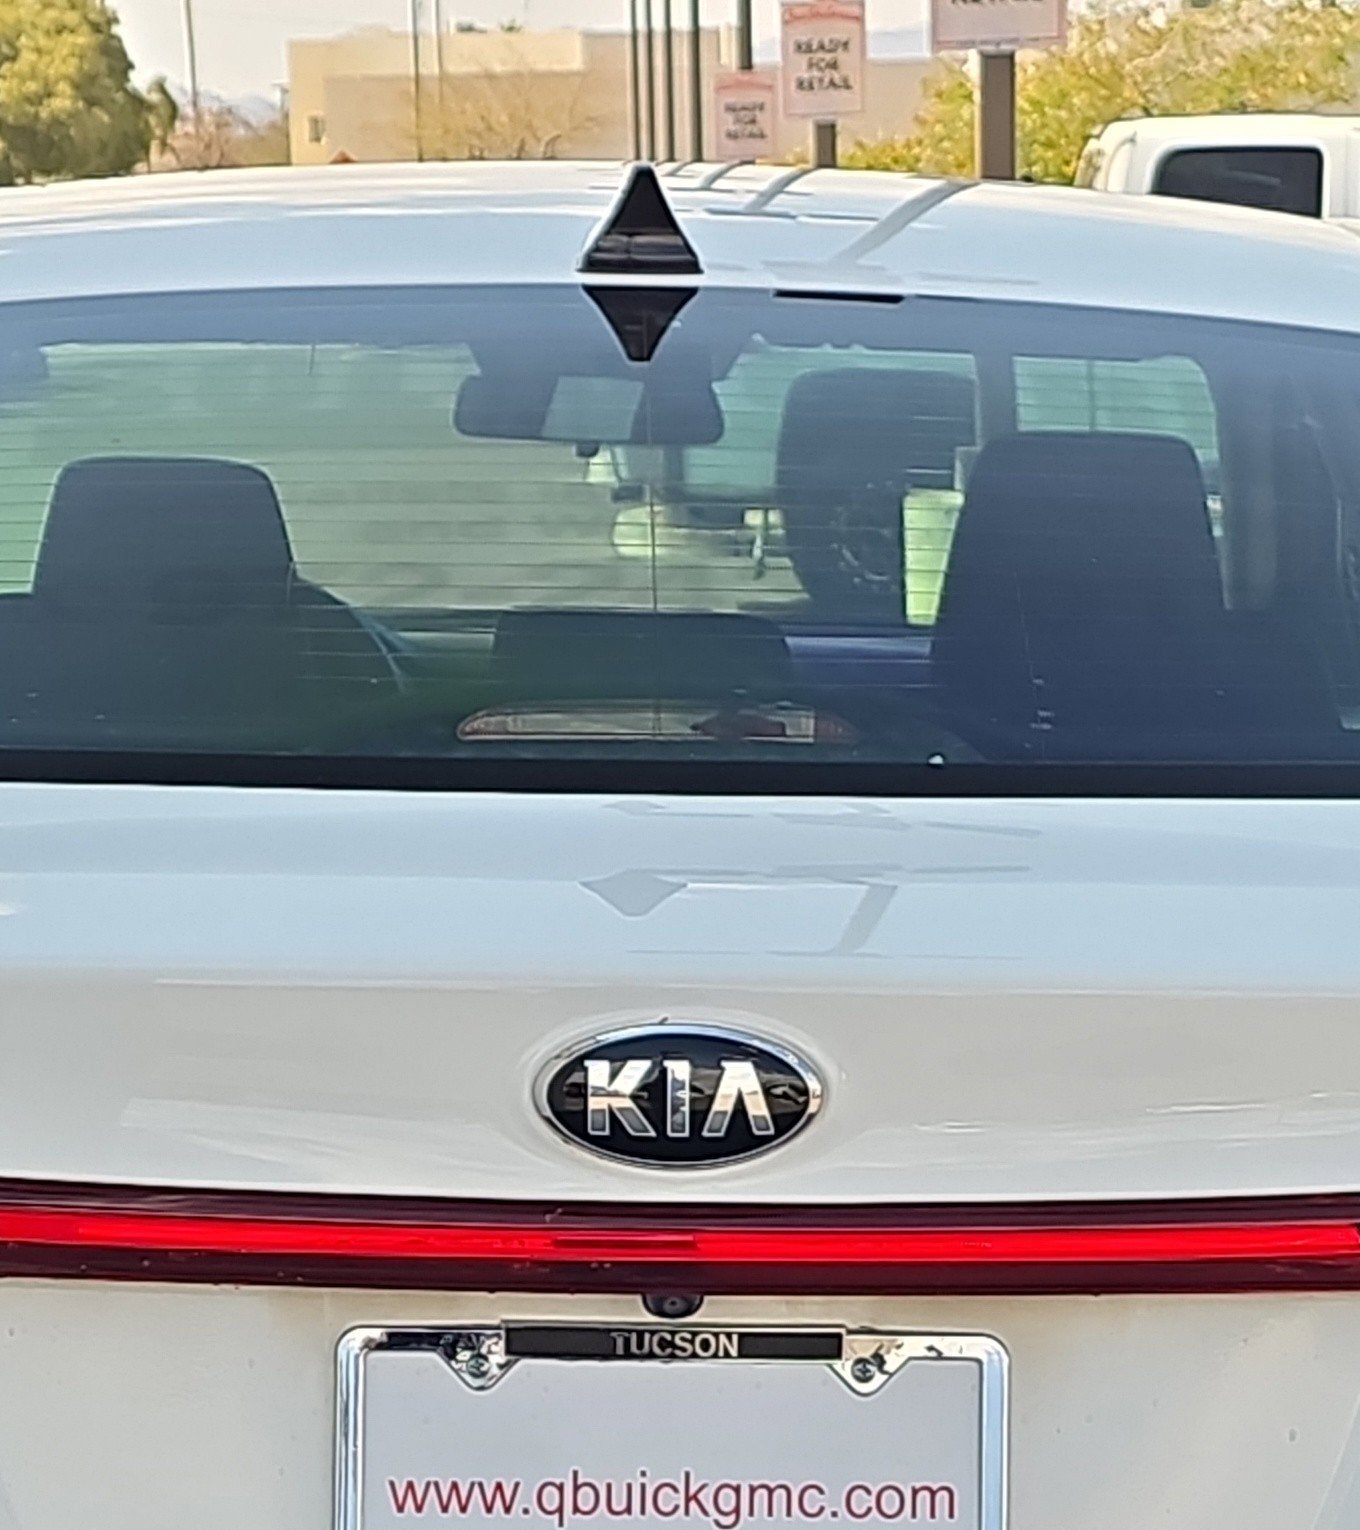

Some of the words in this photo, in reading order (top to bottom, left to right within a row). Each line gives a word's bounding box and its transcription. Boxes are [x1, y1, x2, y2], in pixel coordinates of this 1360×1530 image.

[794, 38, 850, 53] READY
[806, 56, 839, 72] FOR
[796, 75, 853, 91] RETAIL
[584, 1059, 775, 1137] KIA
[610, 1331, 739, 1359] TUCSON
[389, 1470, 956, 1530] www.qbuickgmc.com
